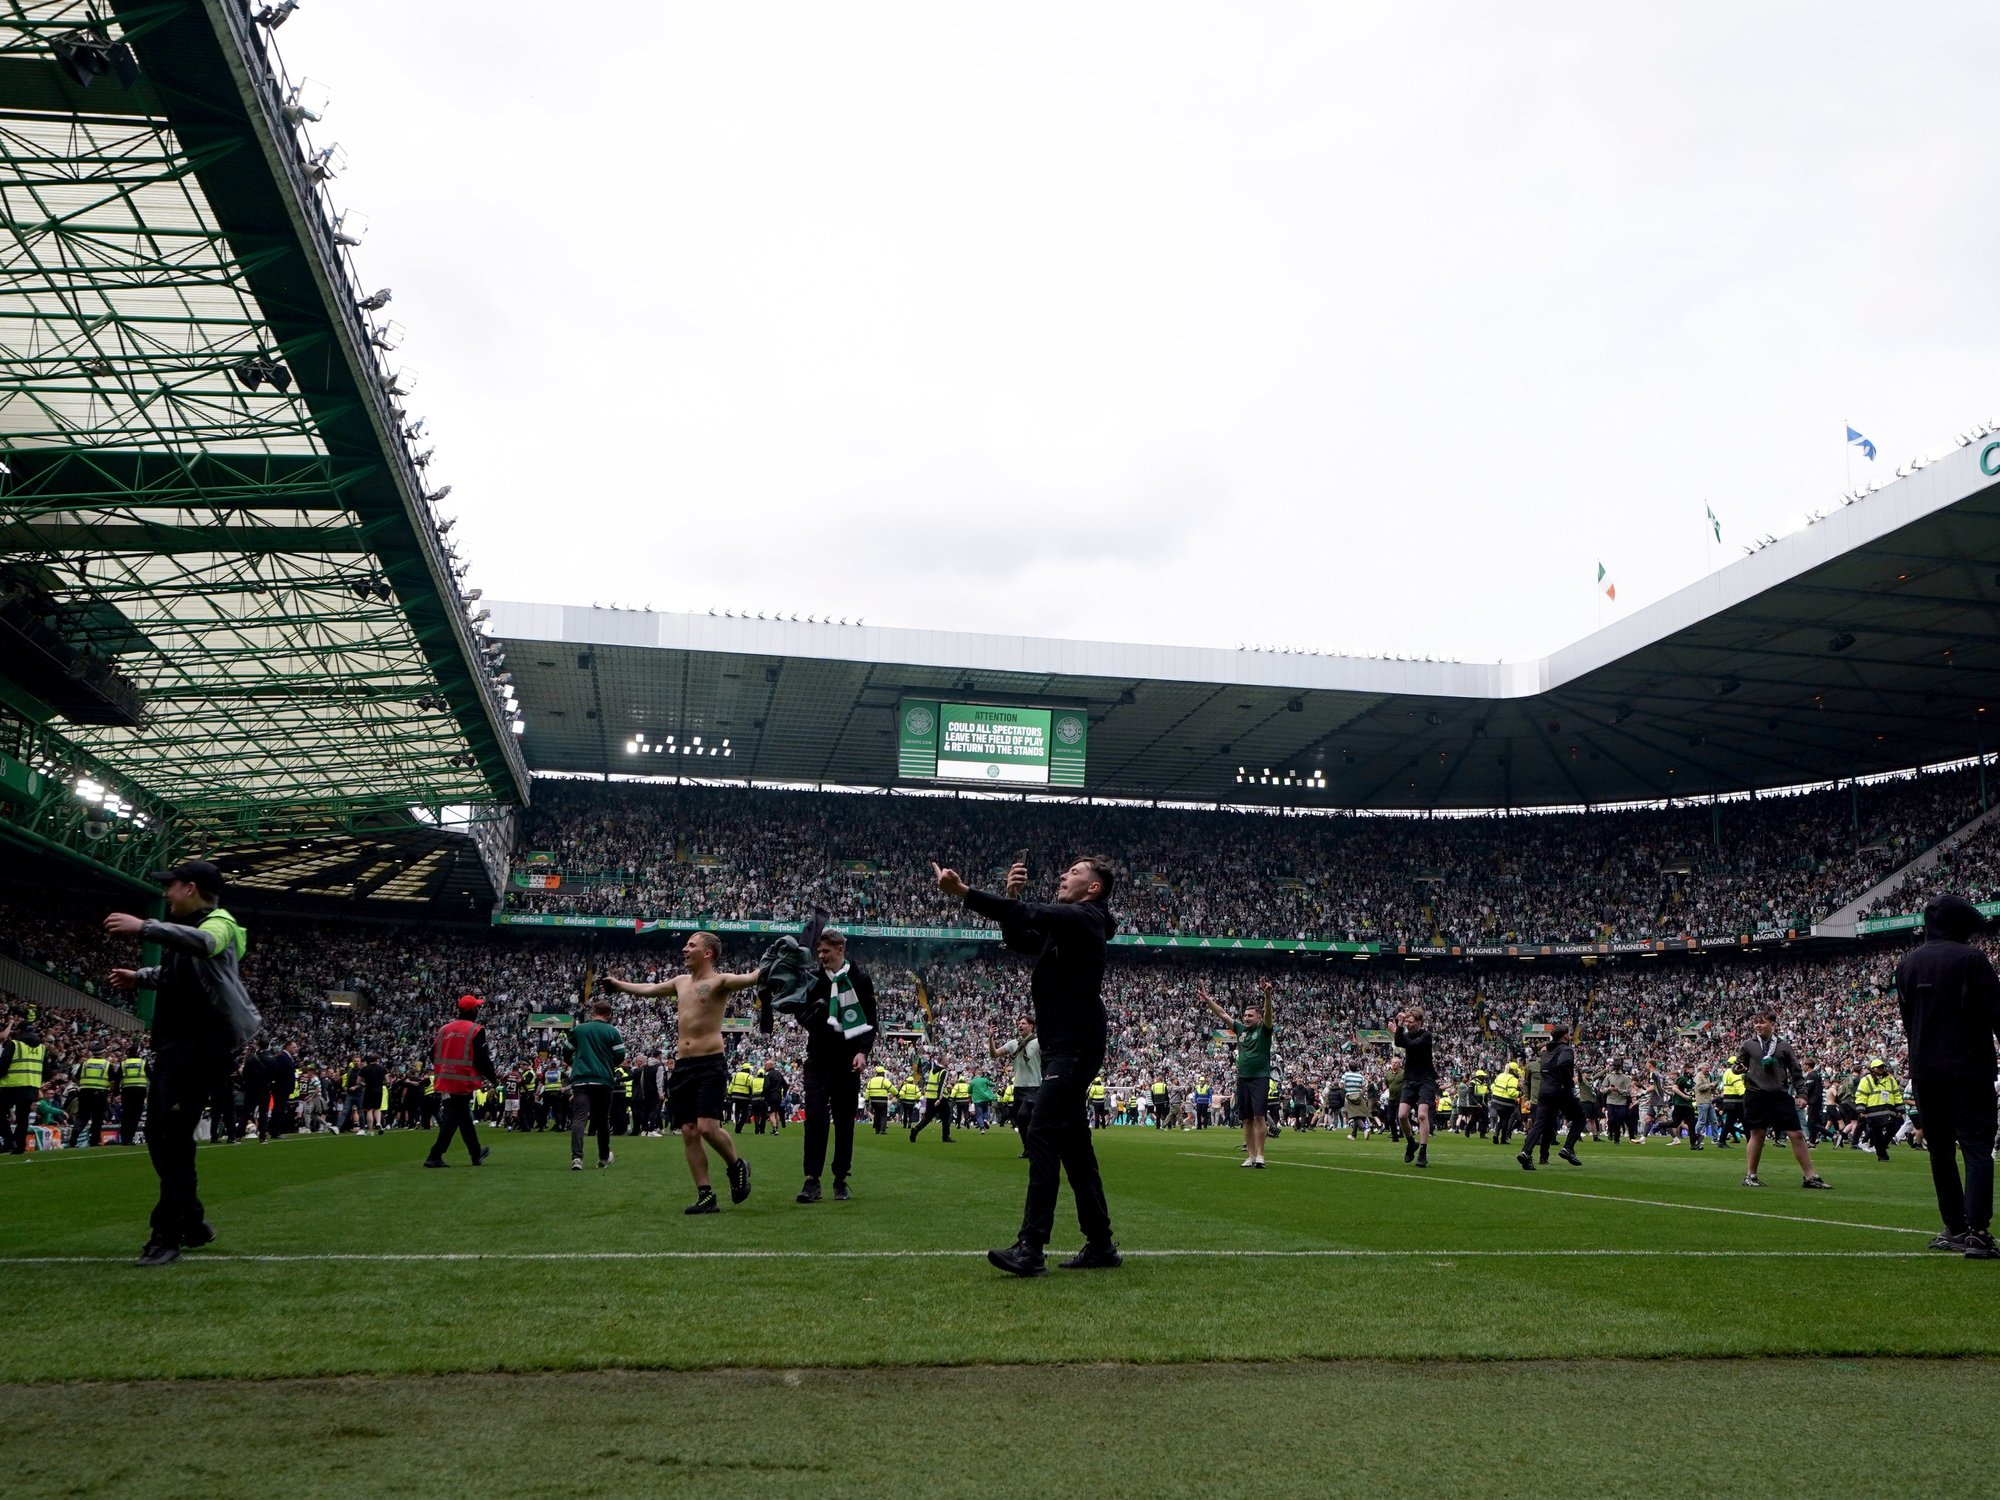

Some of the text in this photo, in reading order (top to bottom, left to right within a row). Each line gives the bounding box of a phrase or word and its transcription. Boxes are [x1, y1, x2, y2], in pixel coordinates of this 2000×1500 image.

[974, 711, 1018, 722] ATTENTION
[948, 722, 1042, 736] COULD ALL SPECTATORS
[945, 732, 1044, 746] LEAVE THE FIELD OF PLAY
[944, 742, 1044, 756] & RETURN TO THE STANDS
[510, 915, 543, 924] dafabet
[563, 917, 596, 925] dafabet
[616, 918, 634, 926] dafa
[668, 920, 699, 928] dafabet
[719, 921, 750, 930] dafabet
[769, 923, 800, 932] dafabet
[882, 928, 942, 936] ELTICFC.NET/STORE
[1701, 937, 1735, 946] MAGNERS
[1556, 945, 1592, 953] MAGNERS
[28, 1047, 38, 1056] 144
[298, 1083, 308, 1091] 19
[506, 1082, 517, 1092] 29
